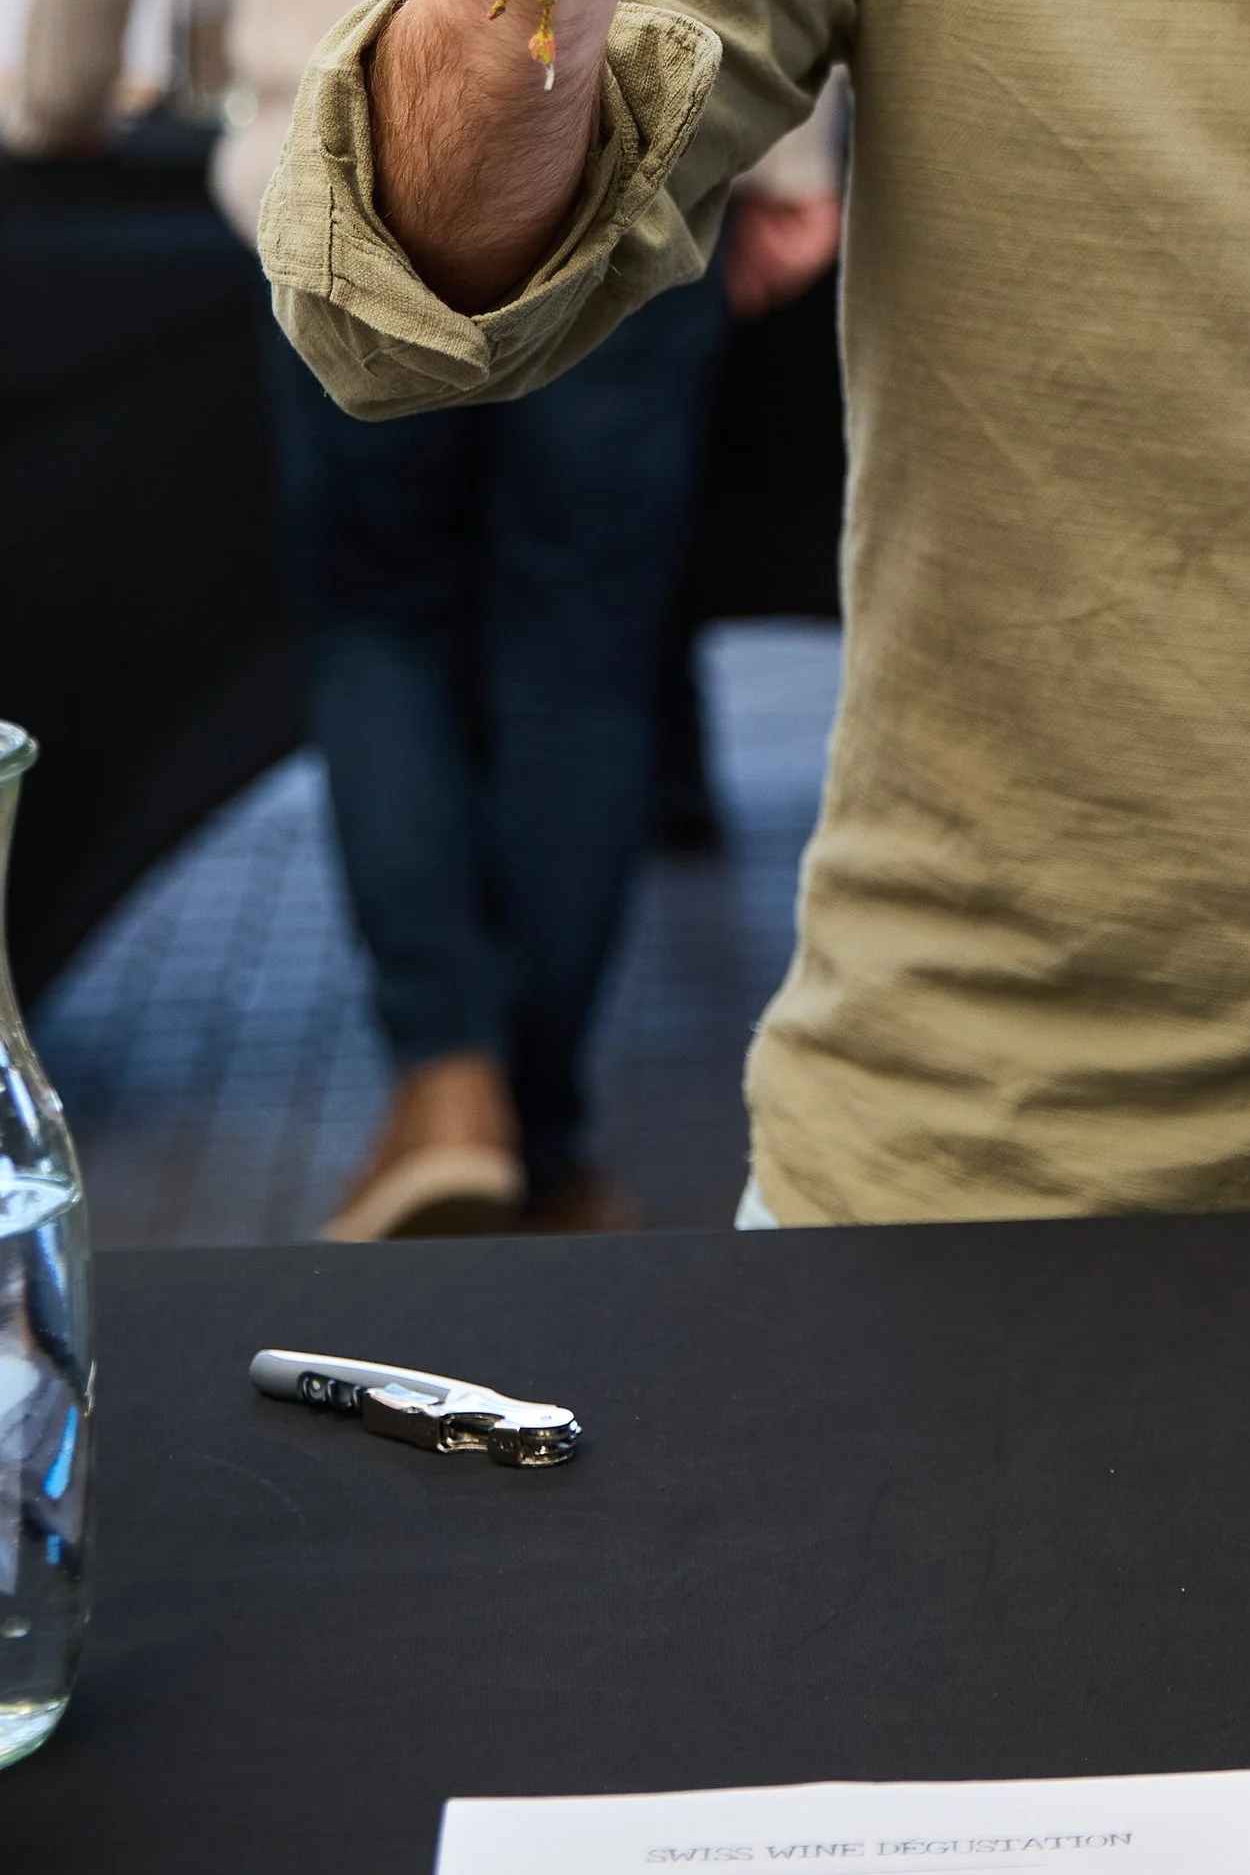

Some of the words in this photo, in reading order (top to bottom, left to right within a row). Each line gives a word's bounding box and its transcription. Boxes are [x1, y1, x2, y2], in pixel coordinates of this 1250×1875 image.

[647, 1845, 754, 1864] SWISS
[765, 1841, 865, 1859] WINE
[877, 1832, 1132, 1857] DÉGUSTATION
